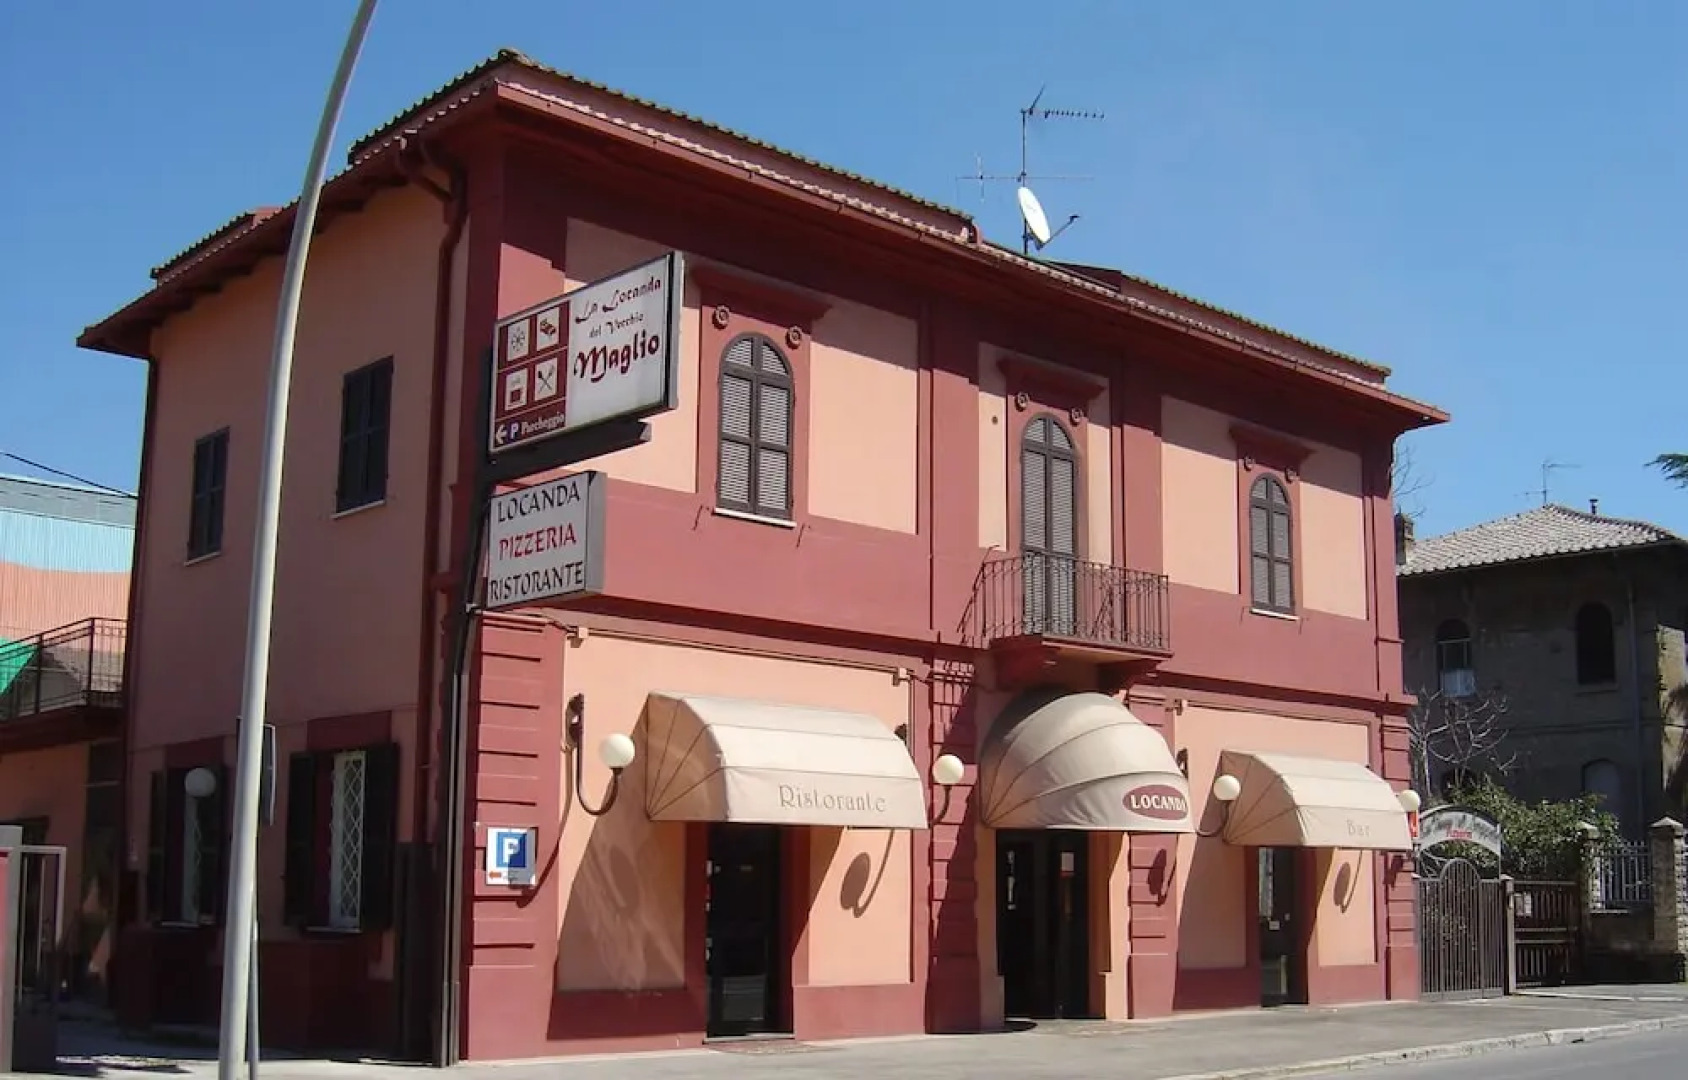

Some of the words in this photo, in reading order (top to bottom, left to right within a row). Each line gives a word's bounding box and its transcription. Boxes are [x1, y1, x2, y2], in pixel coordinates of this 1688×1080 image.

[574, 301, 598, 324] La
[602, 276, 661, 312] Locanda
[589, 324, 601, 338] del
[606, 312, 644, 334] Vecchio
[573, 329, 659, 383] Maglio
[498, 480, 580, 523] LOCANDA
[499, 522, 577, 560] PIZZERIA
[490, 561, 583, 601] RISTORANTE
[779, 784, 886, 812] Ristorante
[503, 837, 520, 864] P
